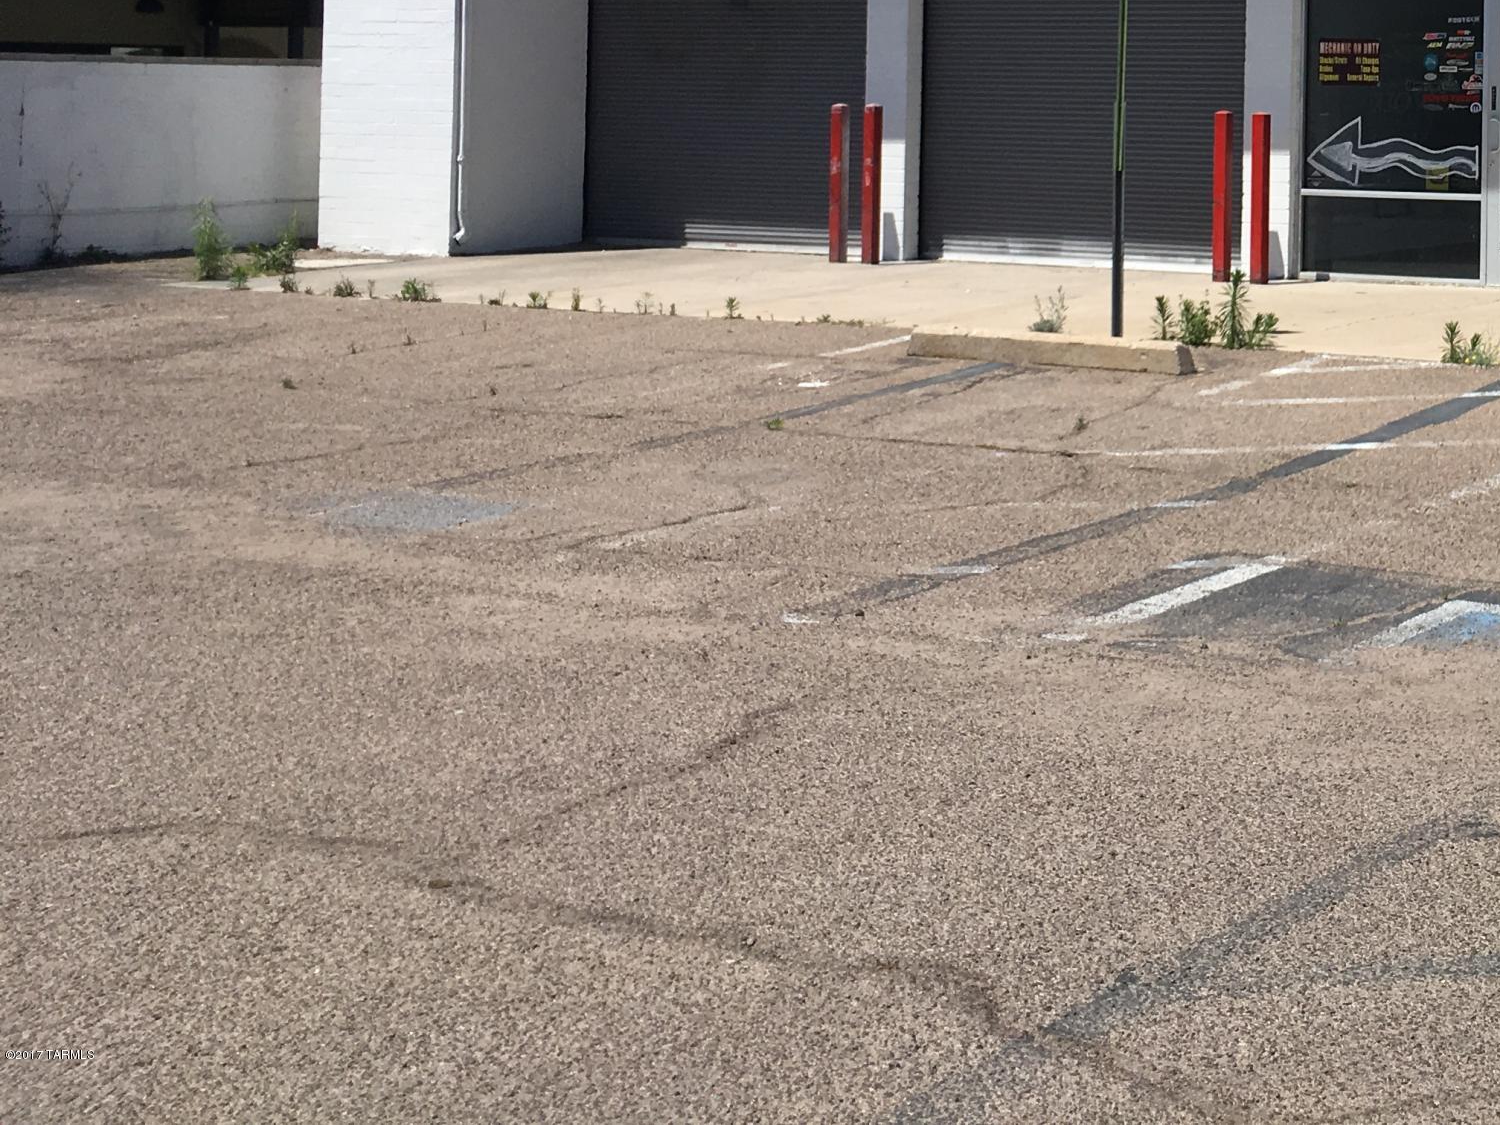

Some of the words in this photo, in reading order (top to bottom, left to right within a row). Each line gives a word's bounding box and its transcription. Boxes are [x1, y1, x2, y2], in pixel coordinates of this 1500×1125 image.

[1320, 42, 1351, 54] MECHANIC
[1353, 43, 1362, 54] ON
[1363, 43, 1380, 54] DUTY
